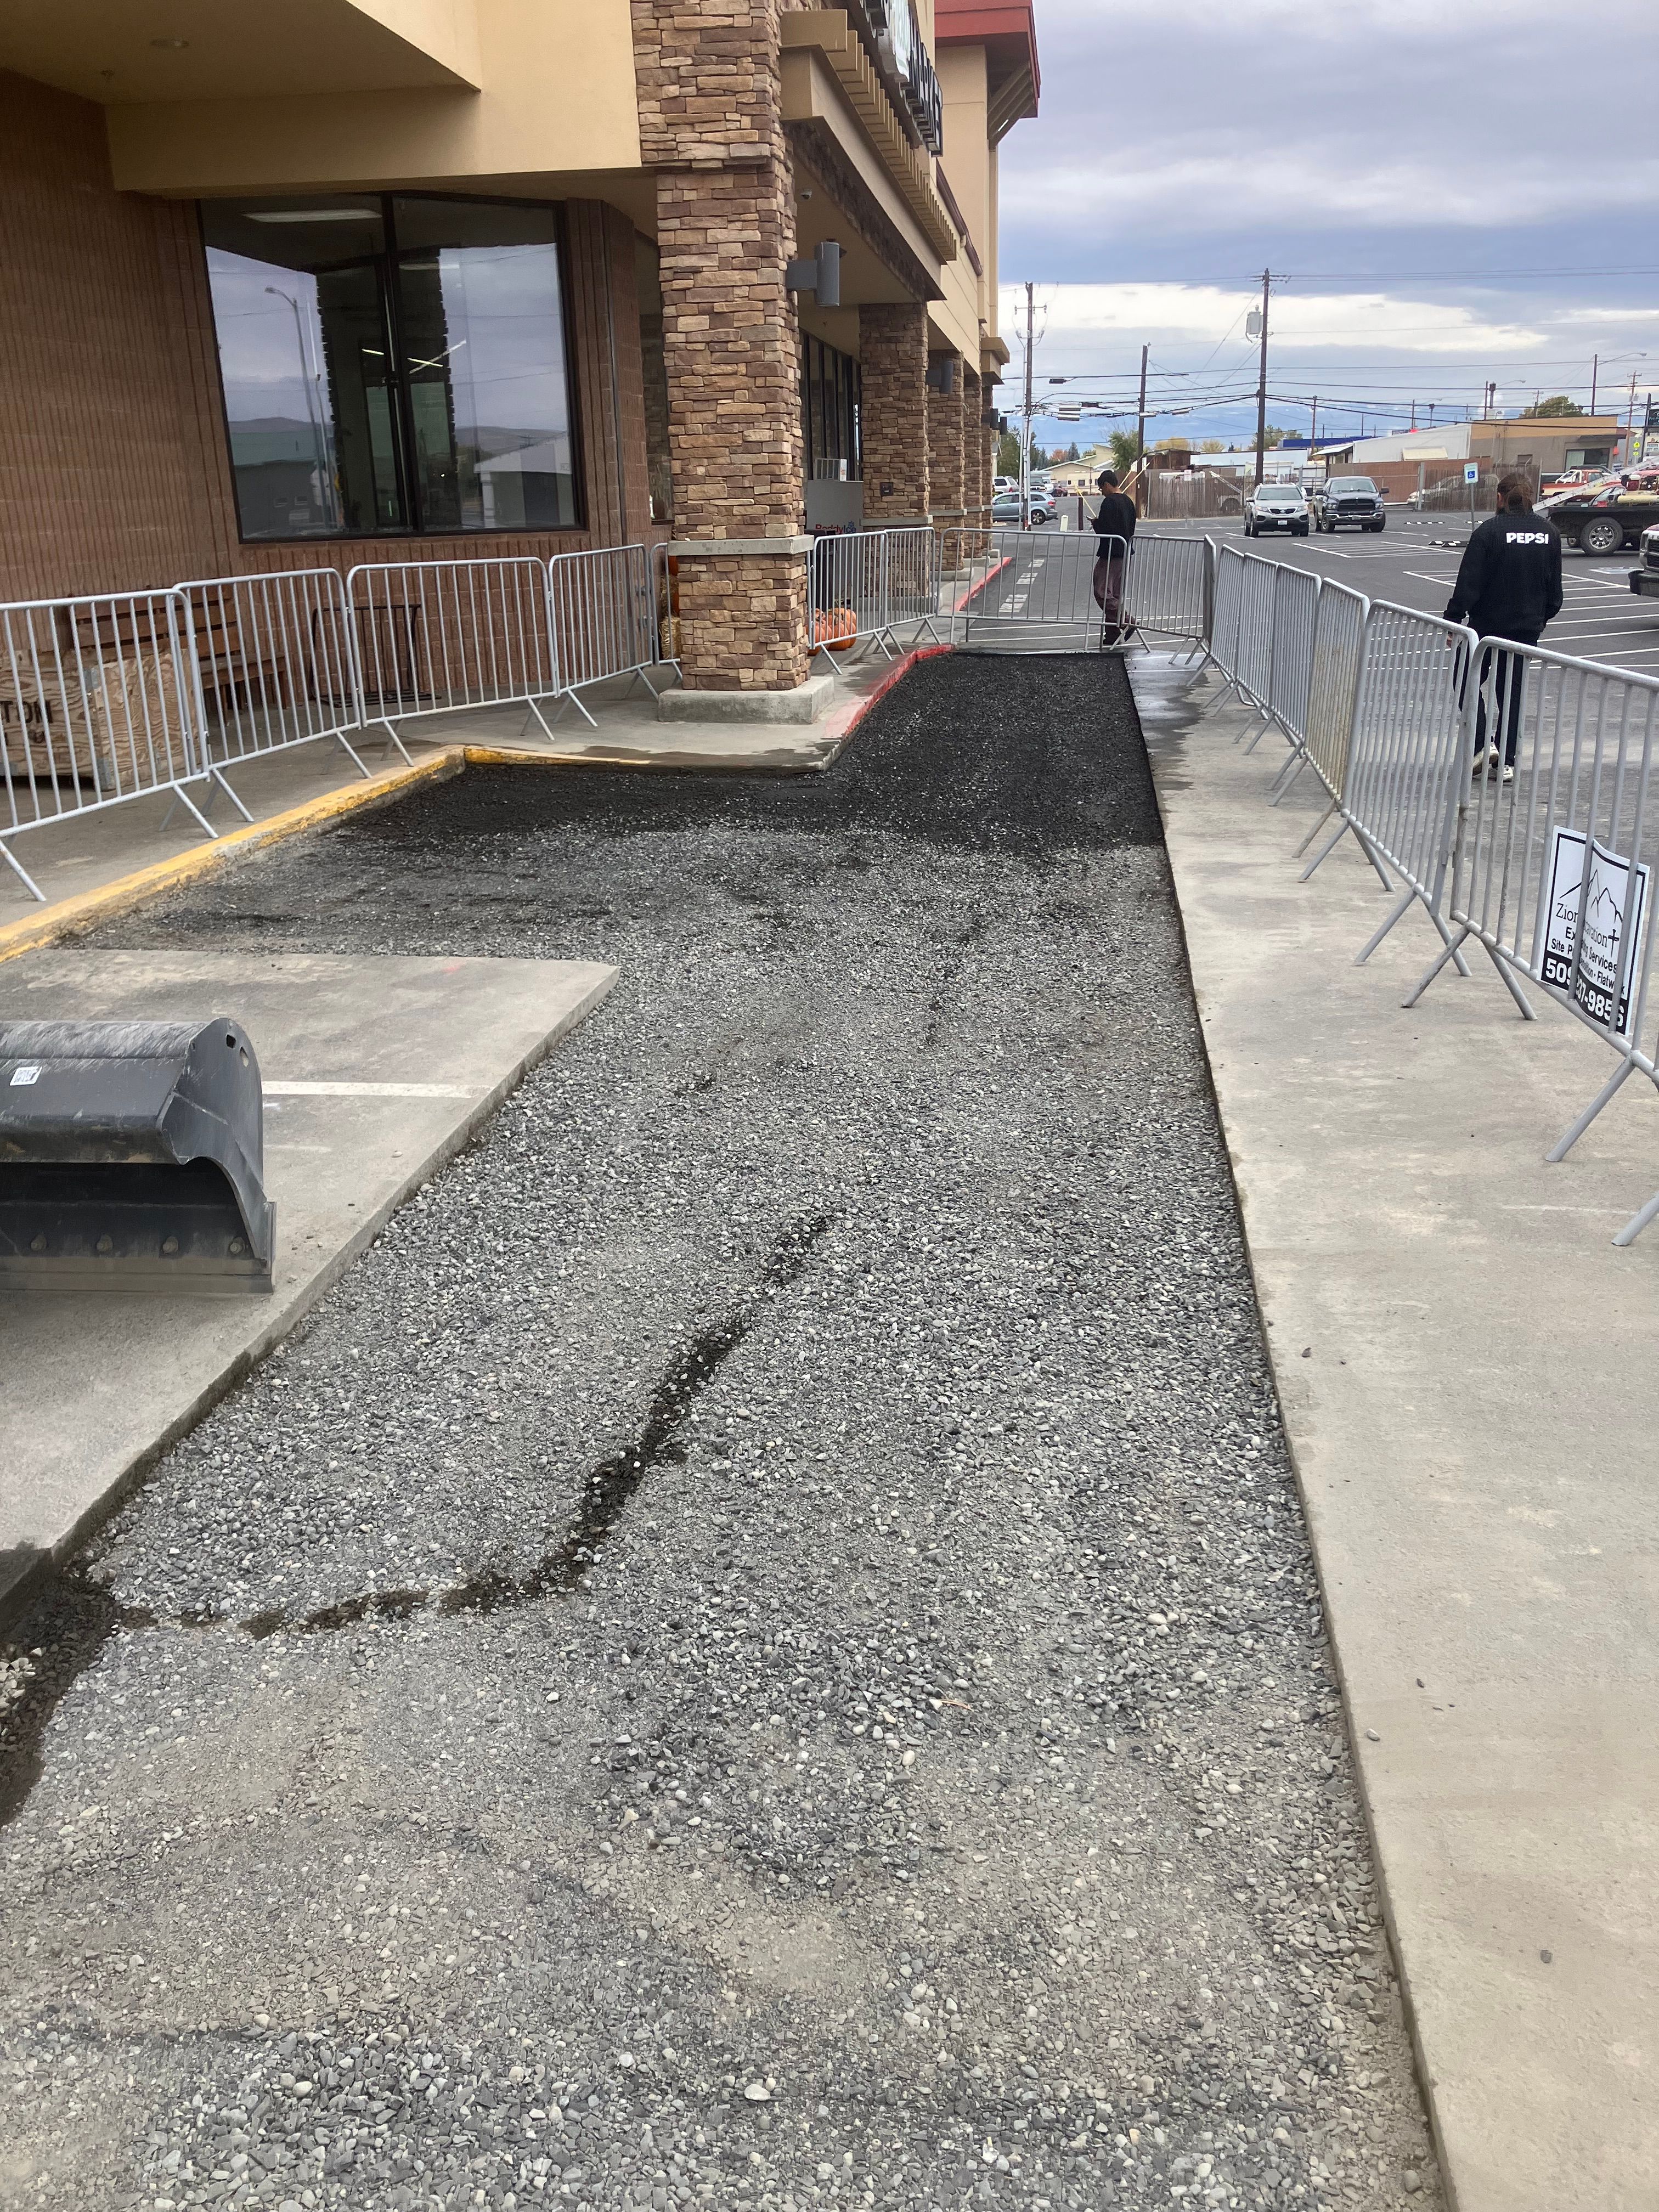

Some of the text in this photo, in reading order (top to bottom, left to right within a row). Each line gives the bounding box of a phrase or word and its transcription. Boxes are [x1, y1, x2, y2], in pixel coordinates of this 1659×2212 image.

[1506, 532, 1549, 544] PEPSI
[1551, 939, 1565, 952] Site
[1589, 946, 1618, 974] Services
